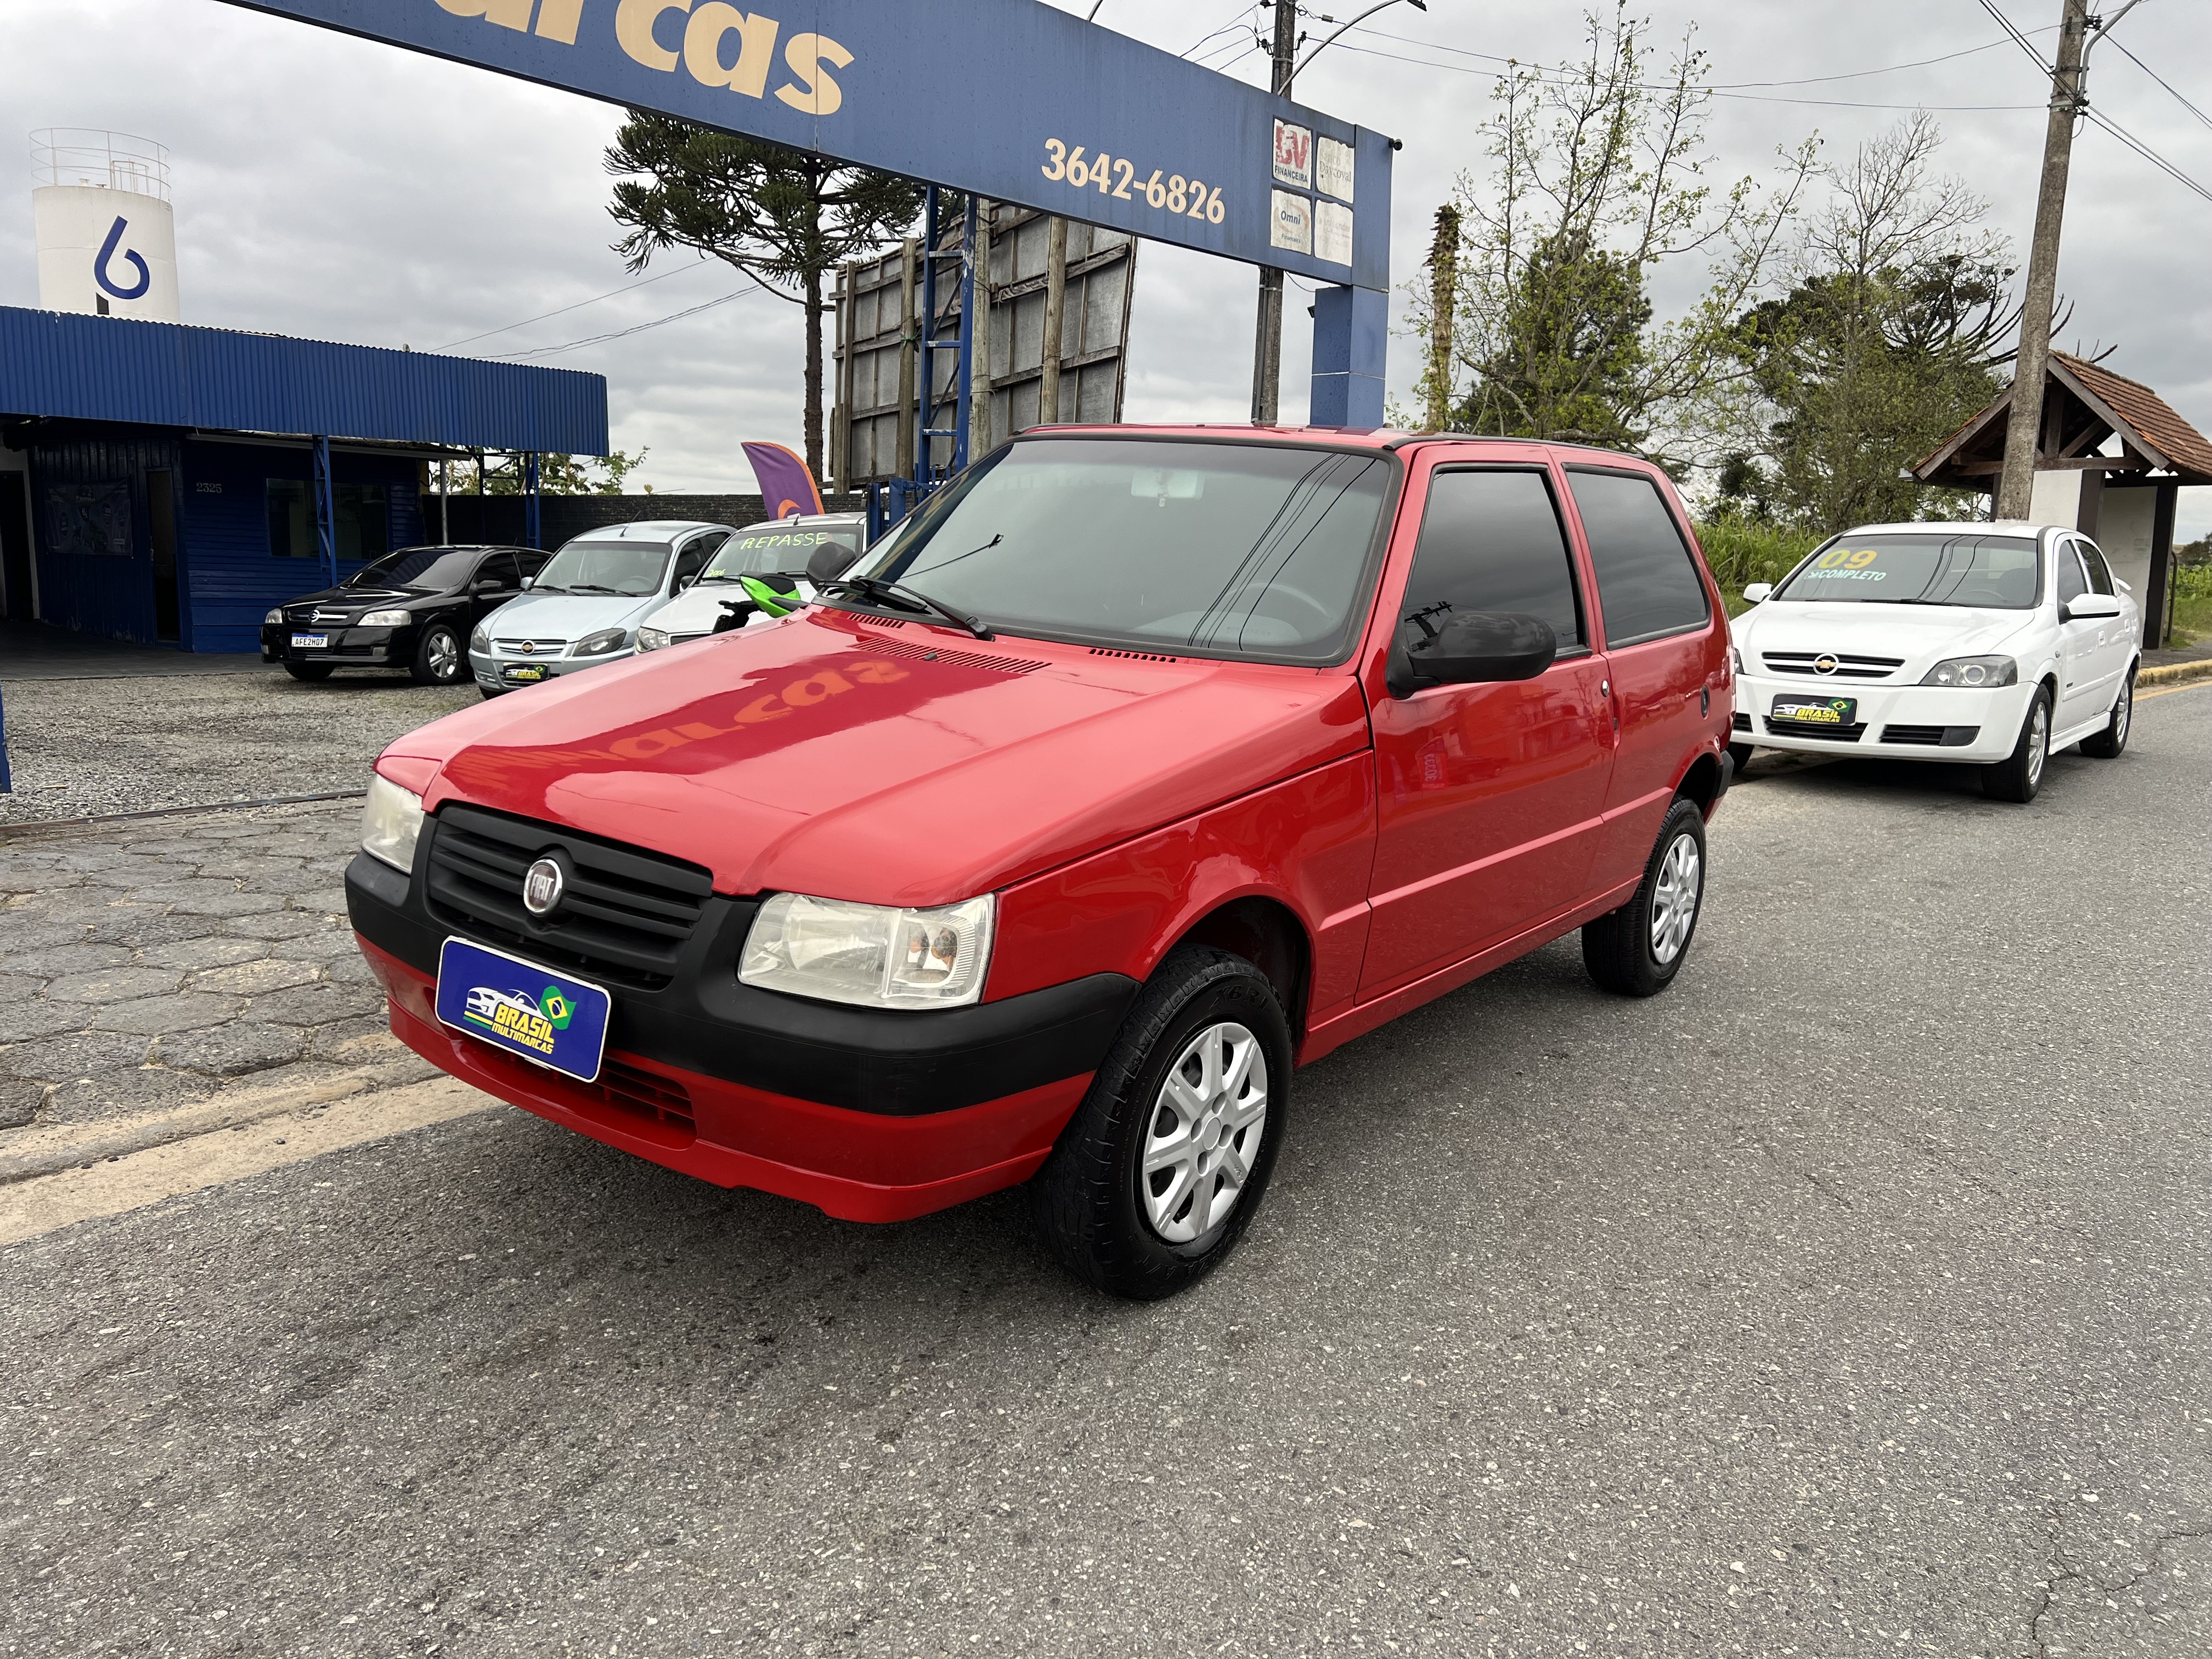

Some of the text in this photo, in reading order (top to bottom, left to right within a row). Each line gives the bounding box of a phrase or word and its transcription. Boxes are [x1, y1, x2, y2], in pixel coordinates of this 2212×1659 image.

[1041, 138, 1225, 224] 3642-6826
[1275, 165, 1308, 183] FINANCEIRA
[1281, 210, 1301, 225] Omni
[740, 532, 828, 550] REPASSE
[1818, 549, 1877, 569] 09
[1818, 569, 1887, 581] COMPLETO
[1796, 708, 1841, 719] BRASIL
[530, 873, 554, 900] FIAT
[494, 1003, 554, 1044] BRASIL
[492, 1022, 554, 1054] MULTIMARCAS
